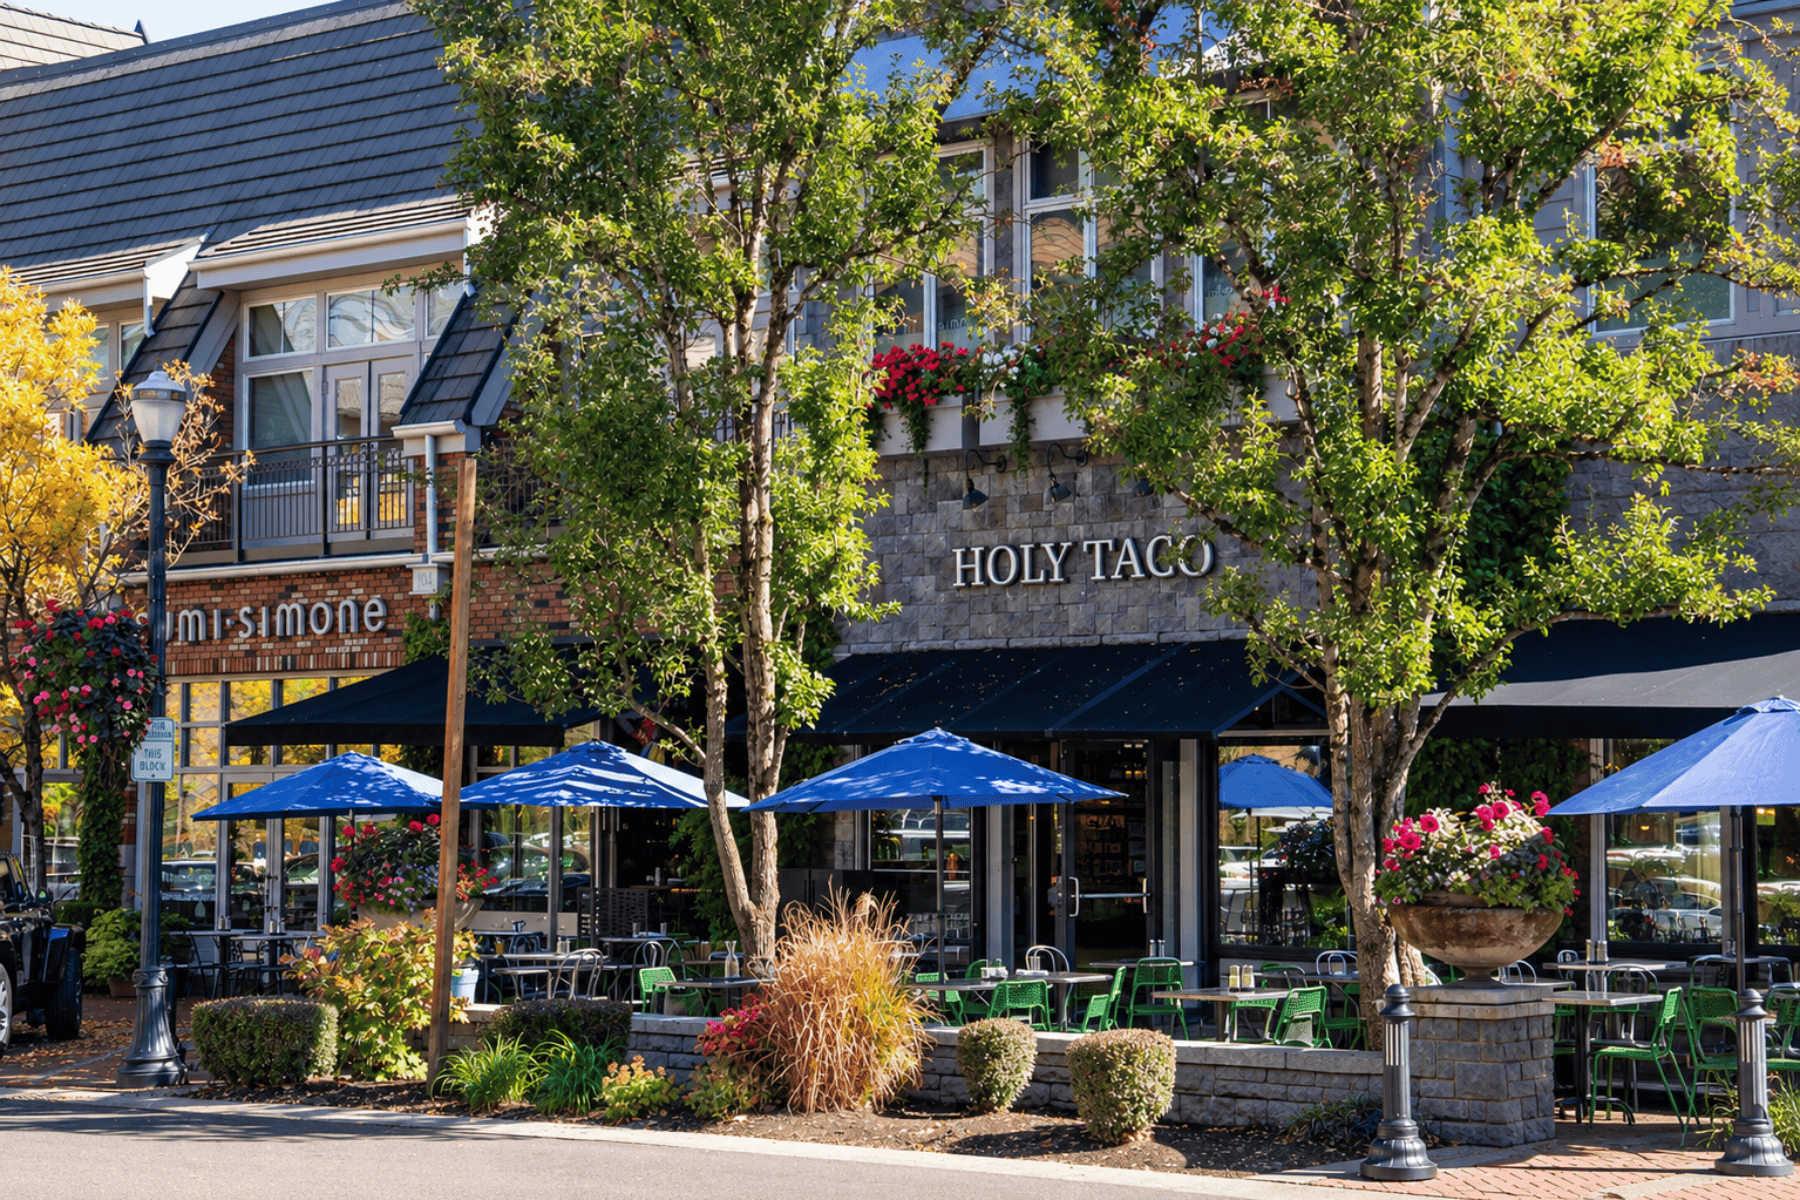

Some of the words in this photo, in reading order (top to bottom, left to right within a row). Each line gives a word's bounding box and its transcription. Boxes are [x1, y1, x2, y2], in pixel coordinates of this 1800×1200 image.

[952, 541, 1072, 587] HOLY
[1083, 535, 1214, 580] TACO
[144, 748, 162, 759] THIS
[139, 761, 166, 771] BLOCK
